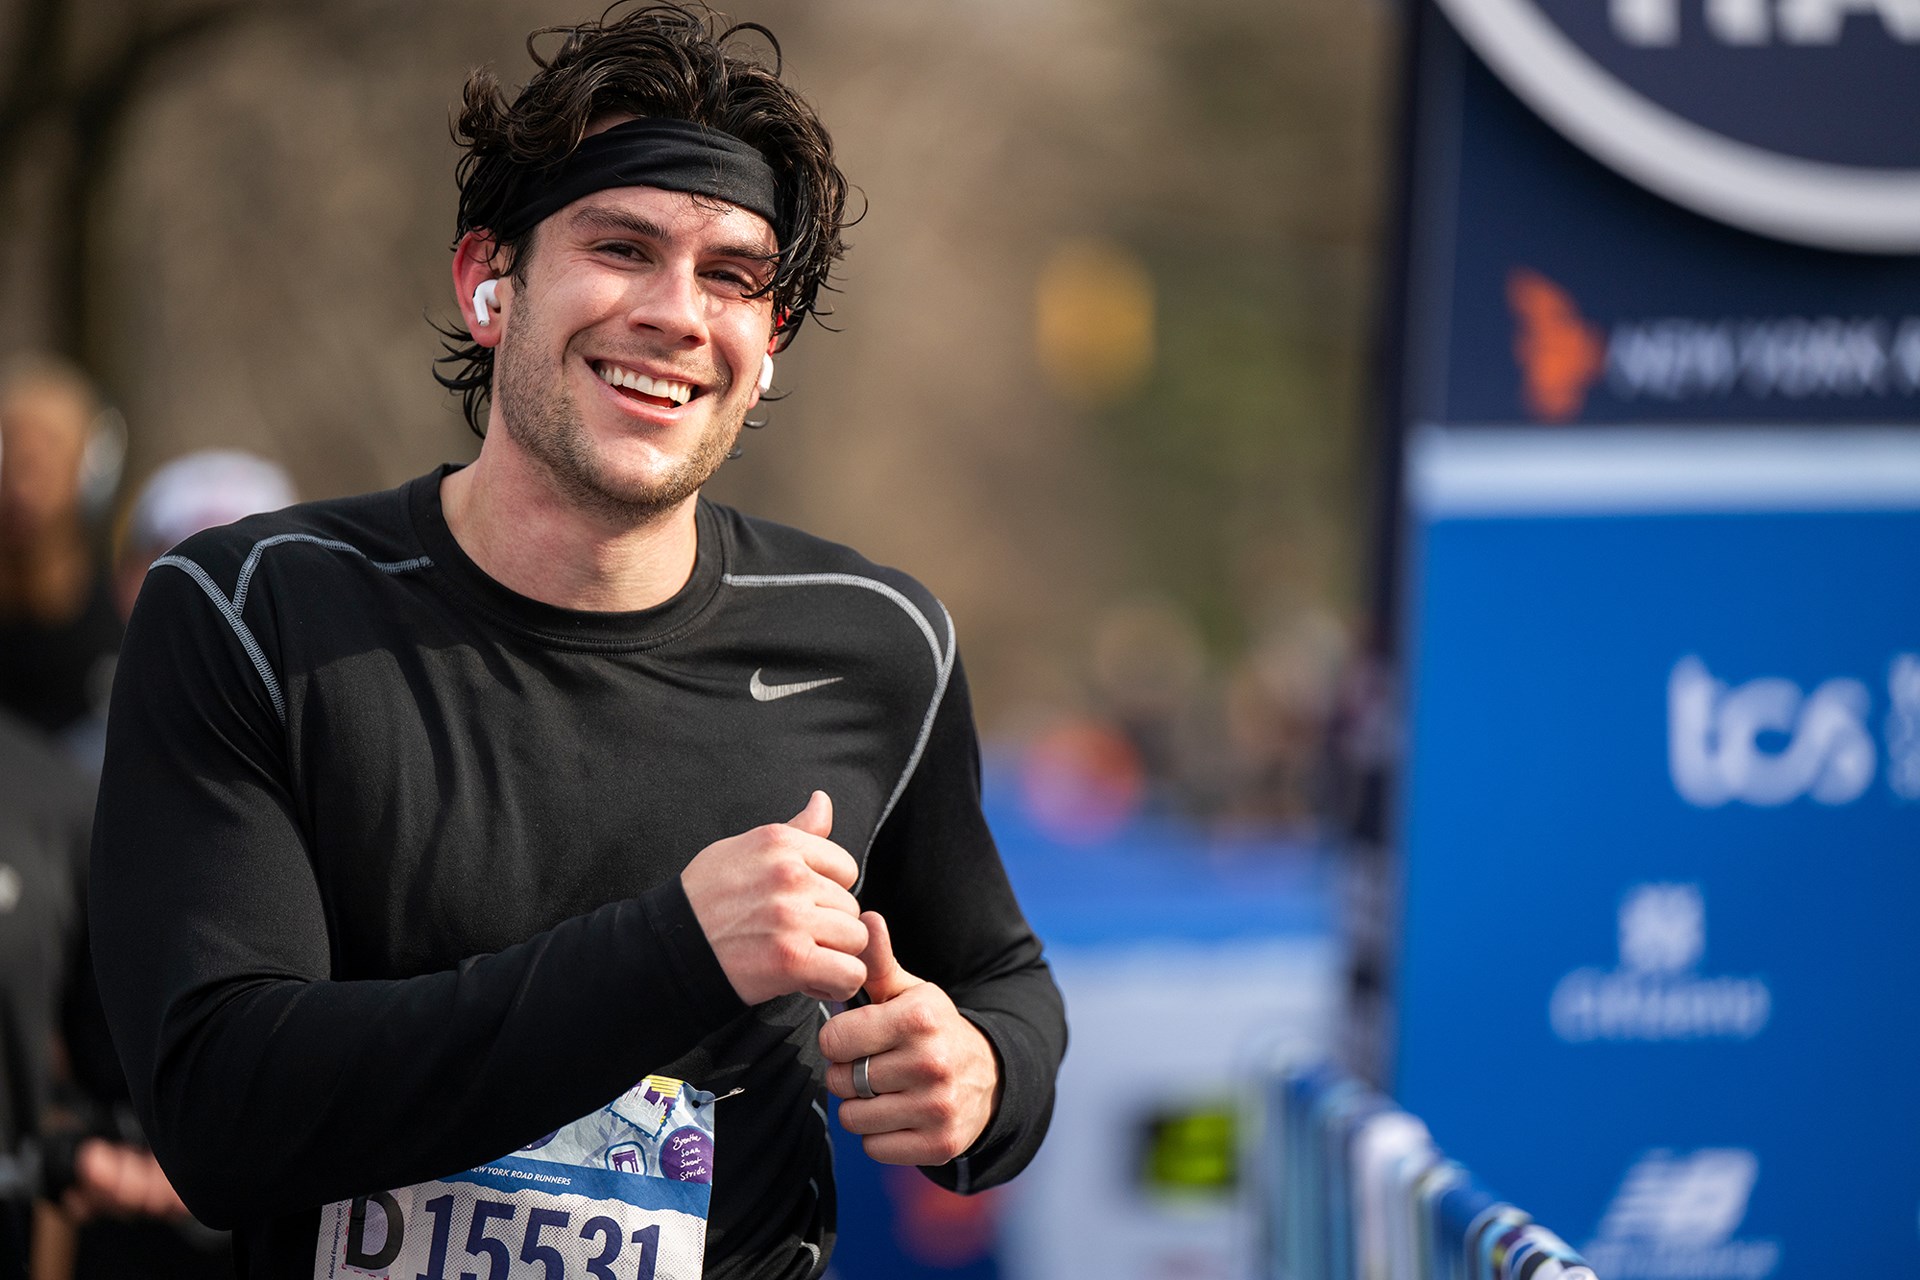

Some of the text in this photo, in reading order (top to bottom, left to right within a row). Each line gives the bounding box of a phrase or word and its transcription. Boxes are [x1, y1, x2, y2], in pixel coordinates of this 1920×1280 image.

[1668, 653, 1875, 806] tcs
[488, 1166, 510, 1177] YORK
[510, 1170, 533, 1180] ROAD
[534, 1173, 571, 1185] RUNNERS
[680, 1166, 706, 1181] Stride
[346, 1190, 404, 1270] D
[416, 1194, 660, 1280] 15531
